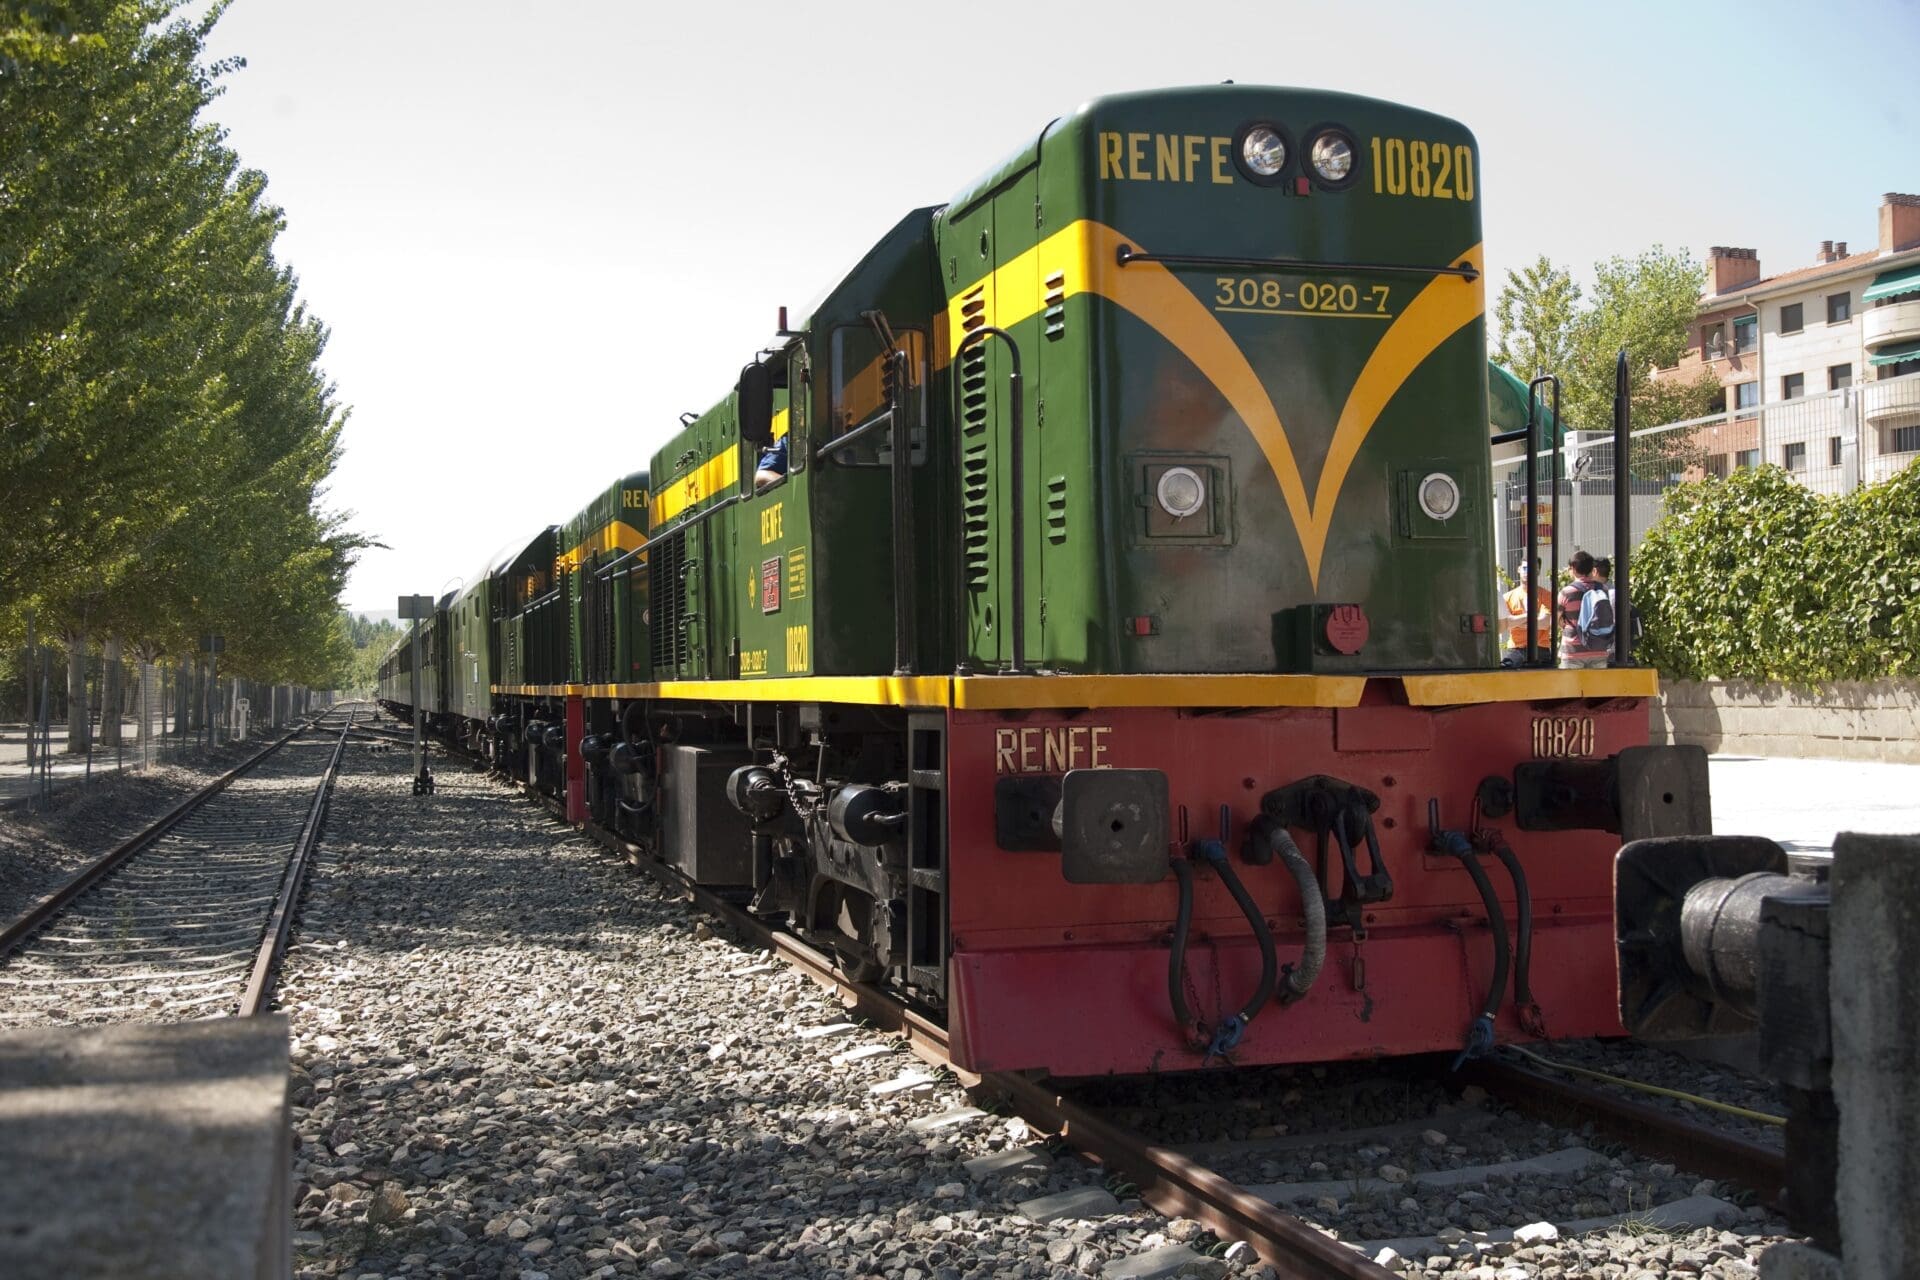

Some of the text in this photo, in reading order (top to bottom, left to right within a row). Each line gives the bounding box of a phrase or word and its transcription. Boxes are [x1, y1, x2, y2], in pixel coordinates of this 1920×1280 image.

[1098, 131, 1234, 185] RENFE
[1371, 137, 1475, 202] 10820
[1215, 278, 1391, 313] 308-020-7
[761, 502, 783, 545] RENFE
[786, 624, 808, 673] 10820
[996, 727, 1113, 773] RENFE
[1532, 717, 1594, 758] 10820
